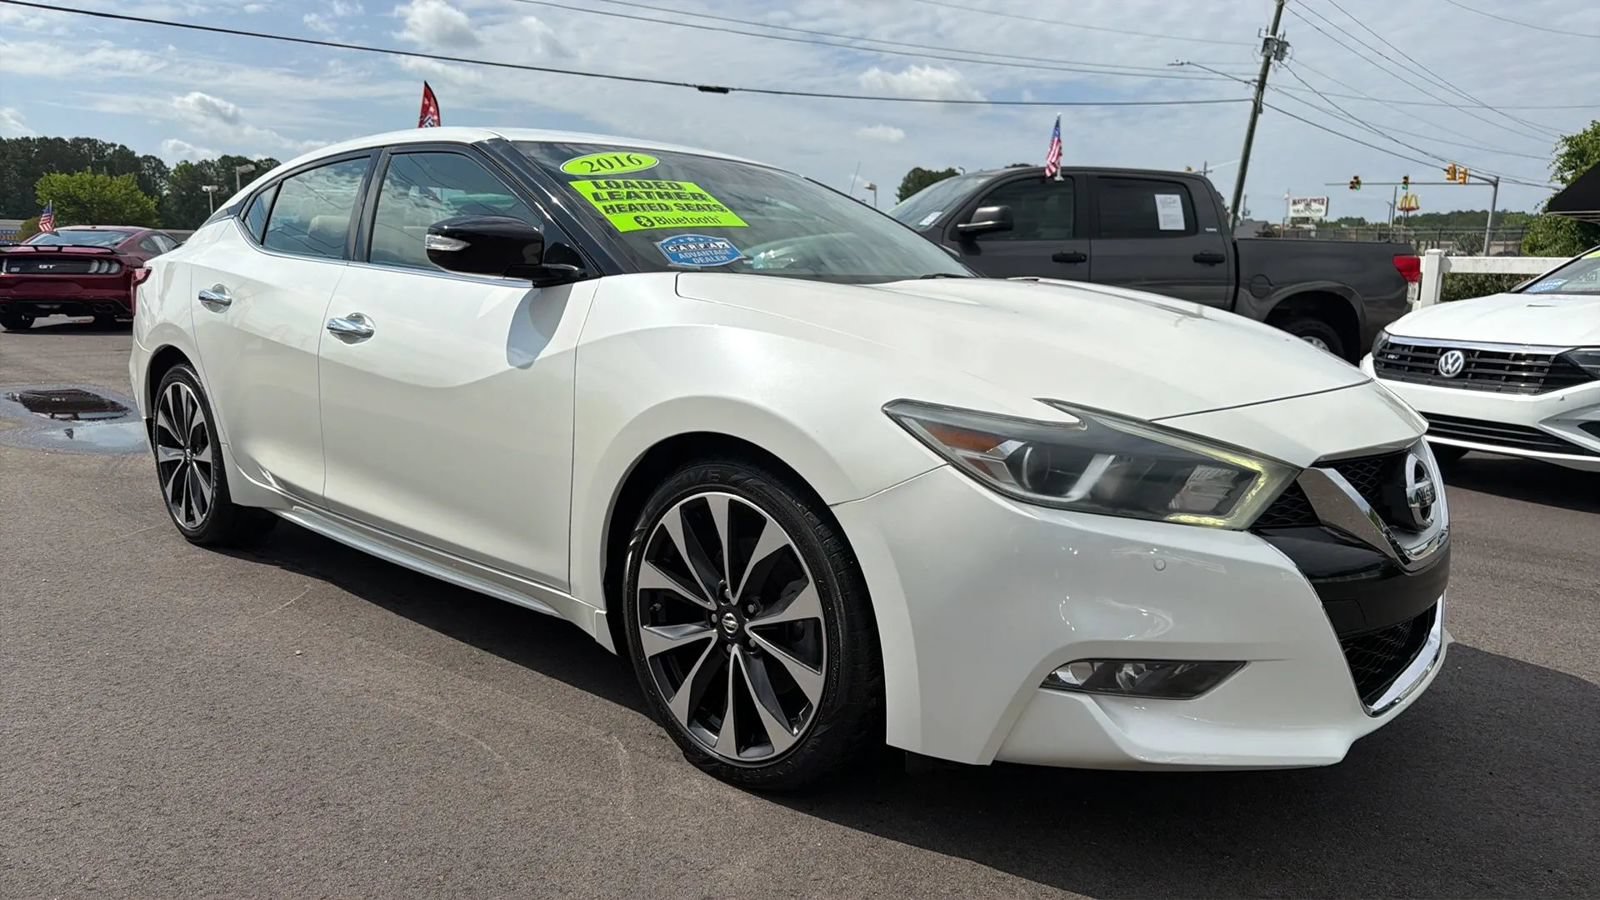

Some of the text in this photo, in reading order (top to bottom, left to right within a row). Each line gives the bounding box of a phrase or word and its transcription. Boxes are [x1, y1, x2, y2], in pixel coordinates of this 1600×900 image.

[580, 152, 643, 173] 2016
[590, 180, 684, 191] LOADED
[592, 190, 710, 202] LEATHER
[603, 202, 727, 214] HEATED SEATS
[653, 215, 717, 225] Bluetooth
[667, 241, 730, 253] CARFAX
[678, 249, 731, 259] ADVANTAGE
[693, 255, 728, 264] DEALER
